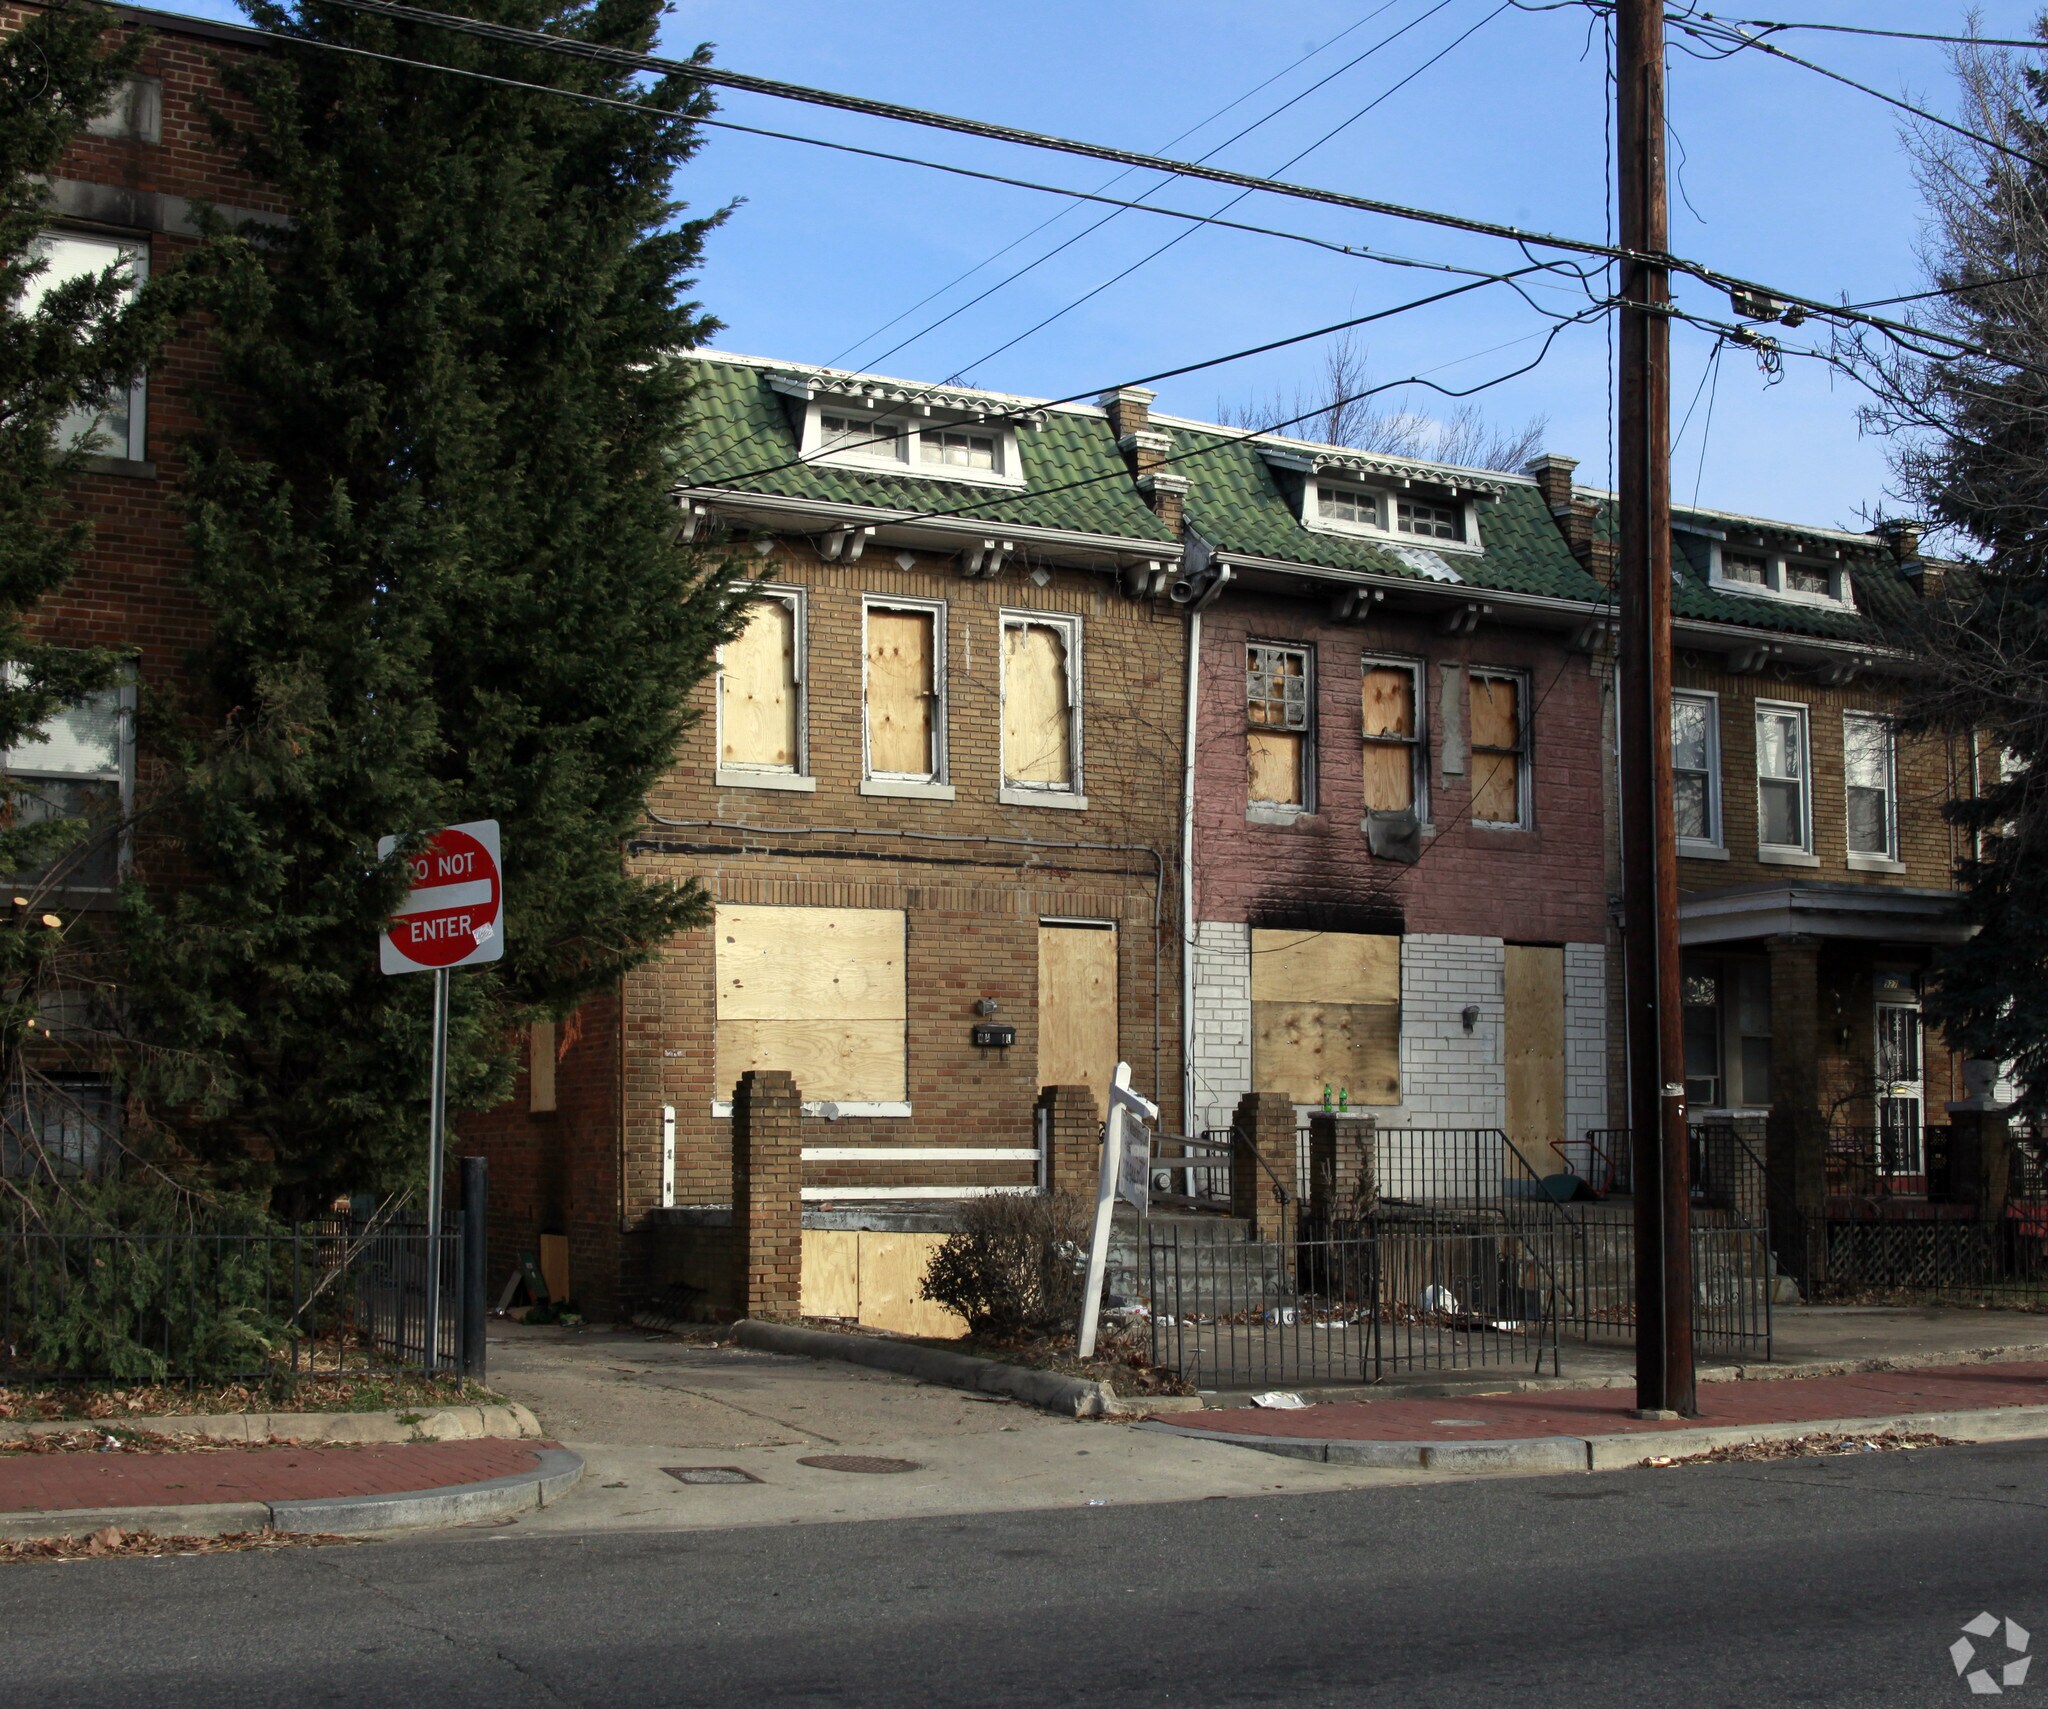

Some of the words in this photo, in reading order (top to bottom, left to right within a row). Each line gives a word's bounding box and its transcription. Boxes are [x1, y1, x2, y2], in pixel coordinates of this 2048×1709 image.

[408, 859, 429, 880] O
[438, 852, 475, 877] NOT
[411, 915, 471, 943] ENTER
